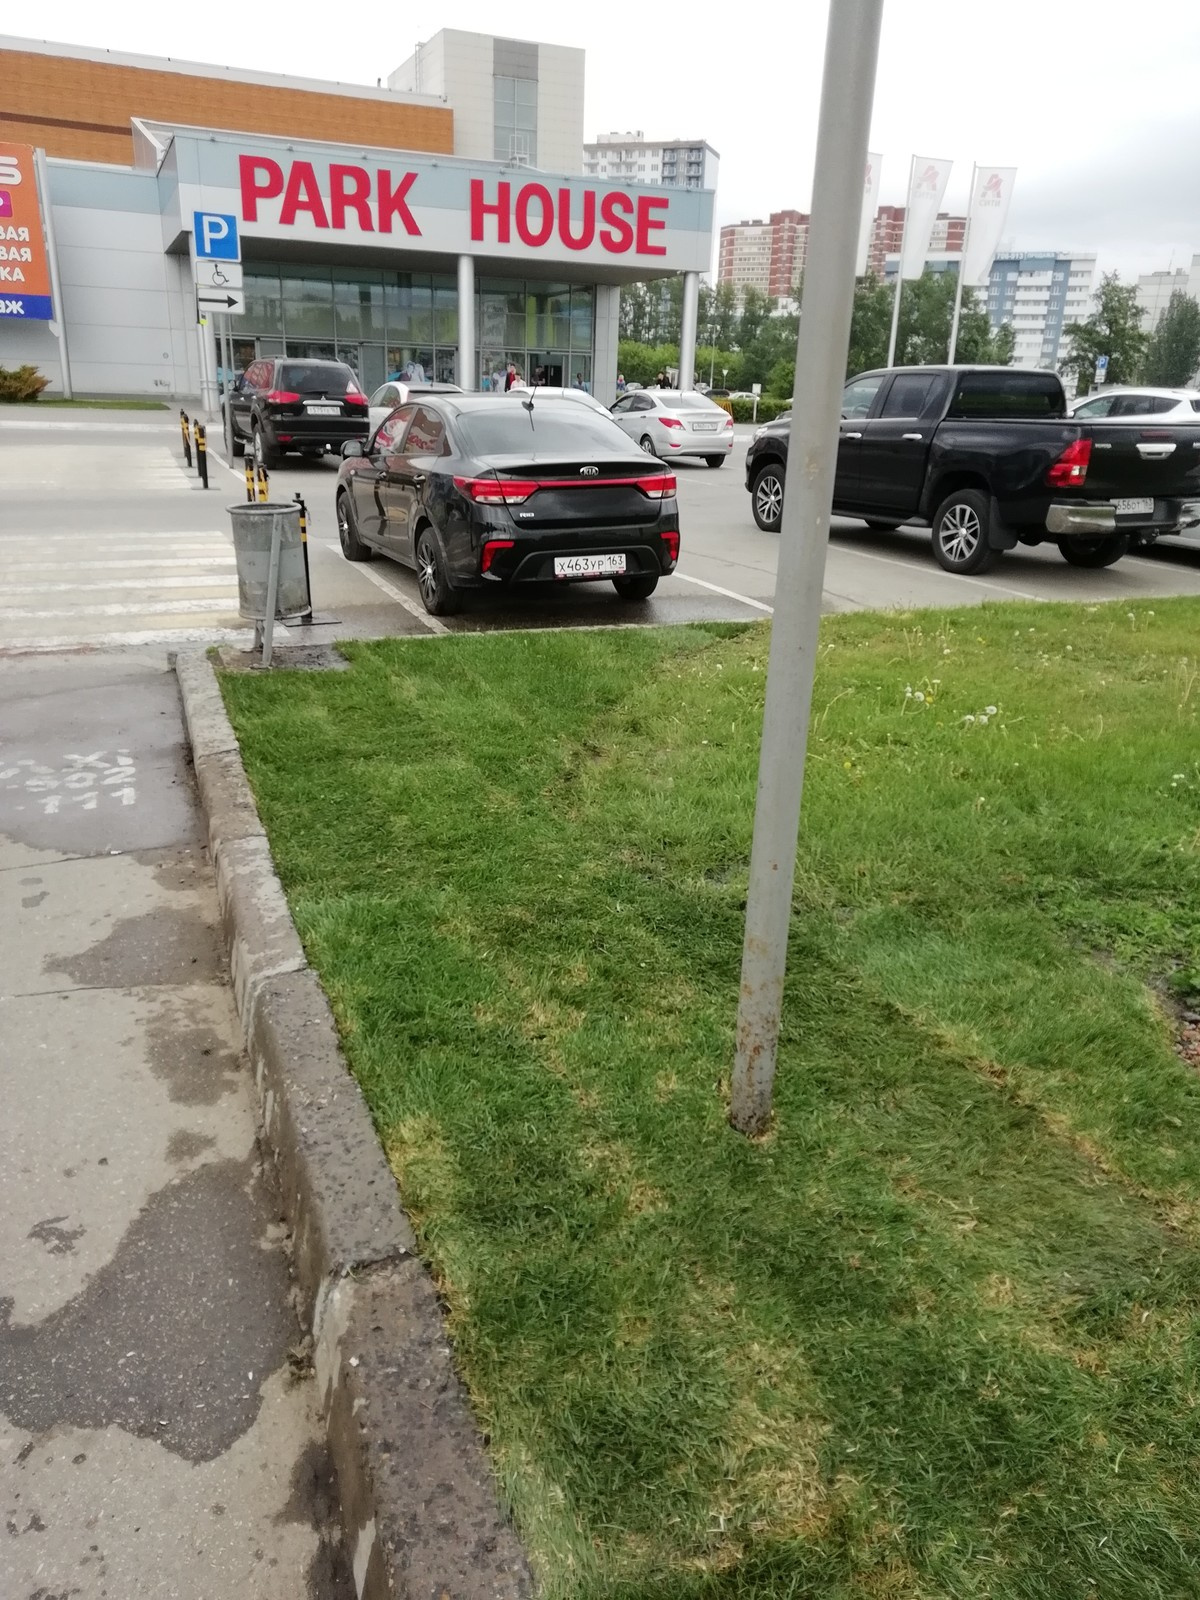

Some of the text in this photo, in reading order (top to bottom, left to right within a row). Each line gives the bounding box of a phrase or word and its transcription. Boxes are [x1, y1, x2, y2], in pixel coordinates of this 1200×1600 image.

[238, 154, 669, 256] PARK HOUSE
[202, 215, 229, 254] P
[583, 467, 597, 476] KIA
[607, 555, 623, 566] 163
